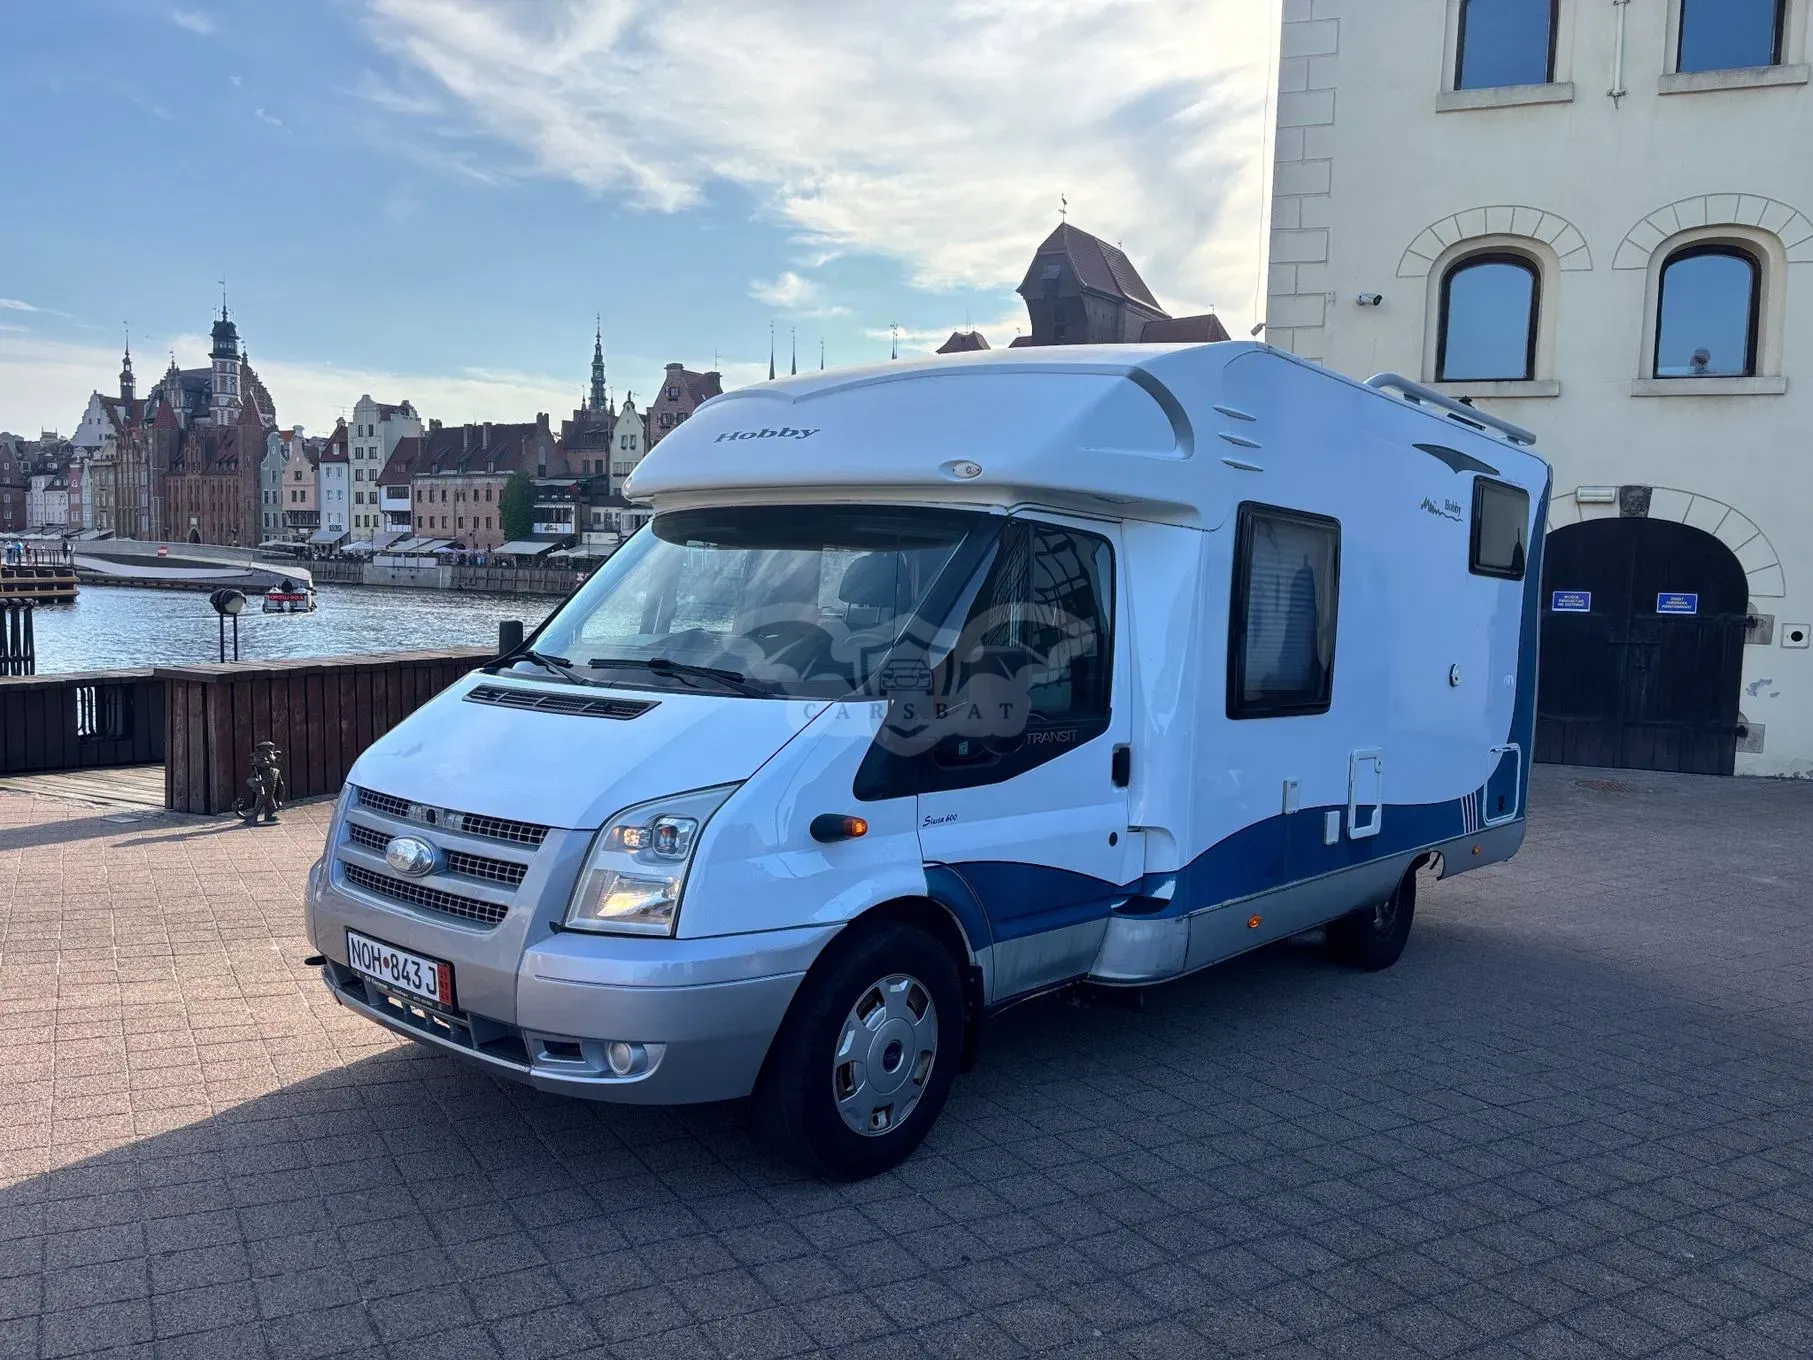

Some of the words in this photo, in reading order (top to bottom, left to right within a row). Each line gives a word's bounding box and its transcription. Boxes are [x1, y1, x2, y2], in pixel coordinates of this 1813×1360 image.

[713, 427, 821, 443] Hobby
[1027, 729, 1078, 744] TRANSIT
[351, 938, 382, 975] NOH
